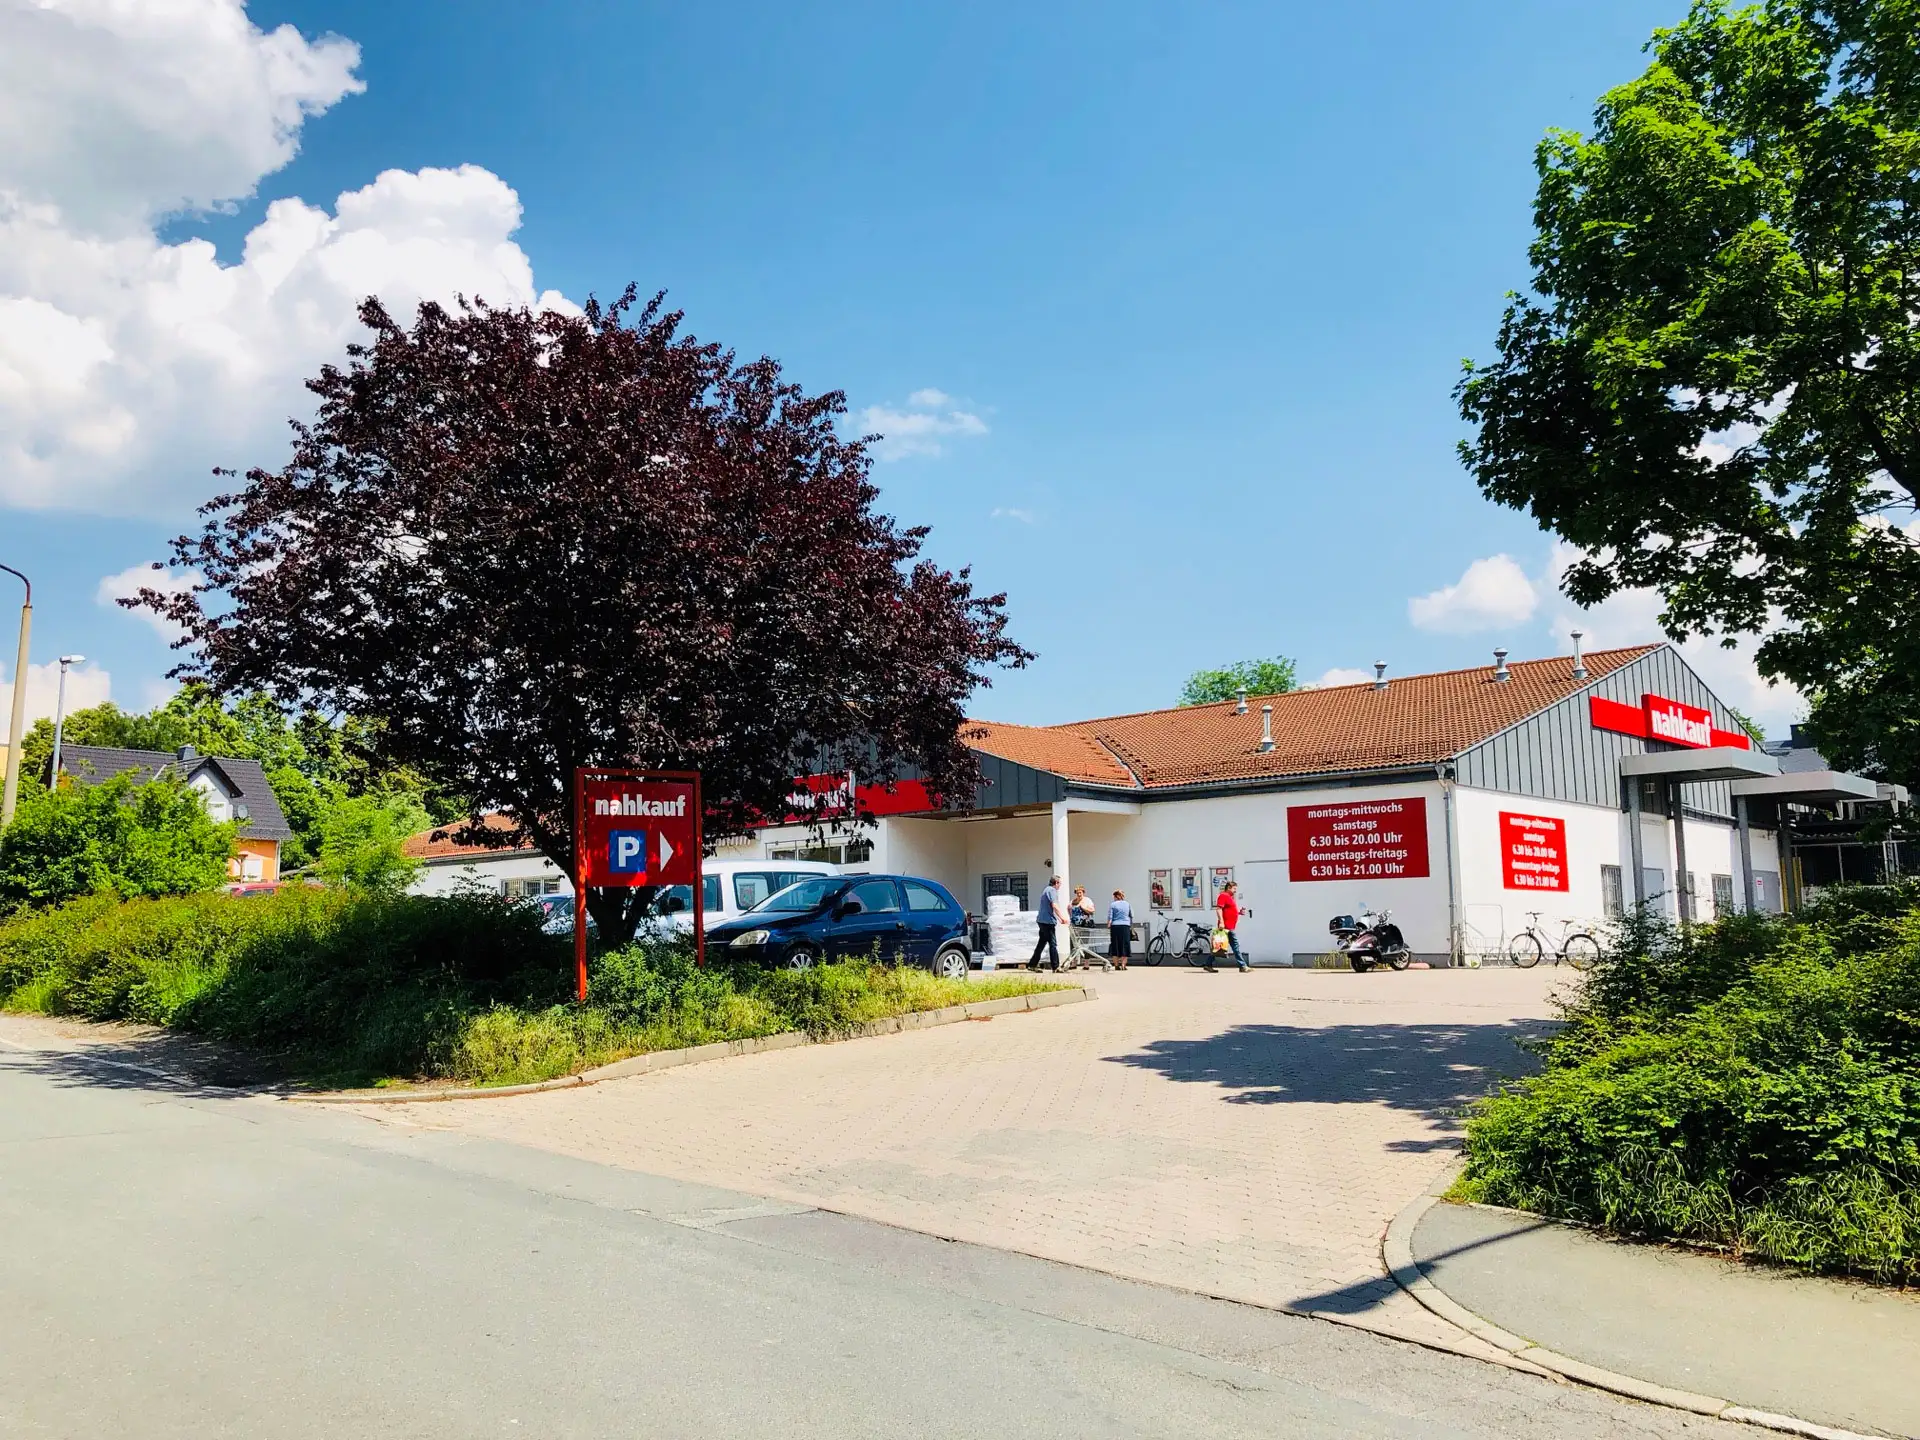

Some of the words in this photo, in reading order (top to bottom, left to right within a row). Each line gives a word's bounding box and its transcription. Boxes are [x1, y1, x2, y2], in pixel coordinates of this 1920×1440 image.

[1651, 705, 1711, 747] nahkauf
[595, 794, 686, 816] nahkauf
[1308, 802, 1403, 818] montags-mittwochs
[1332, 820, 1378, 831] samstags
[1309, 836, 1332, 847] 6.30
[1333, 835, 1350, 846] bis
[1352, 833, 1380, 845] 20.00
[1383, 832, 1403, 843] Uhr
[618, 836, 640, 867] P
[1307, 848, 1408, 862] donnerstags-freitags
[1311, 865, 1333, 876] 6.30
[1335, 864, 1351, 875] bis
[1353, 864, 1382, 875] 21.00
[1384, 863, 1405, 873] Uhr
